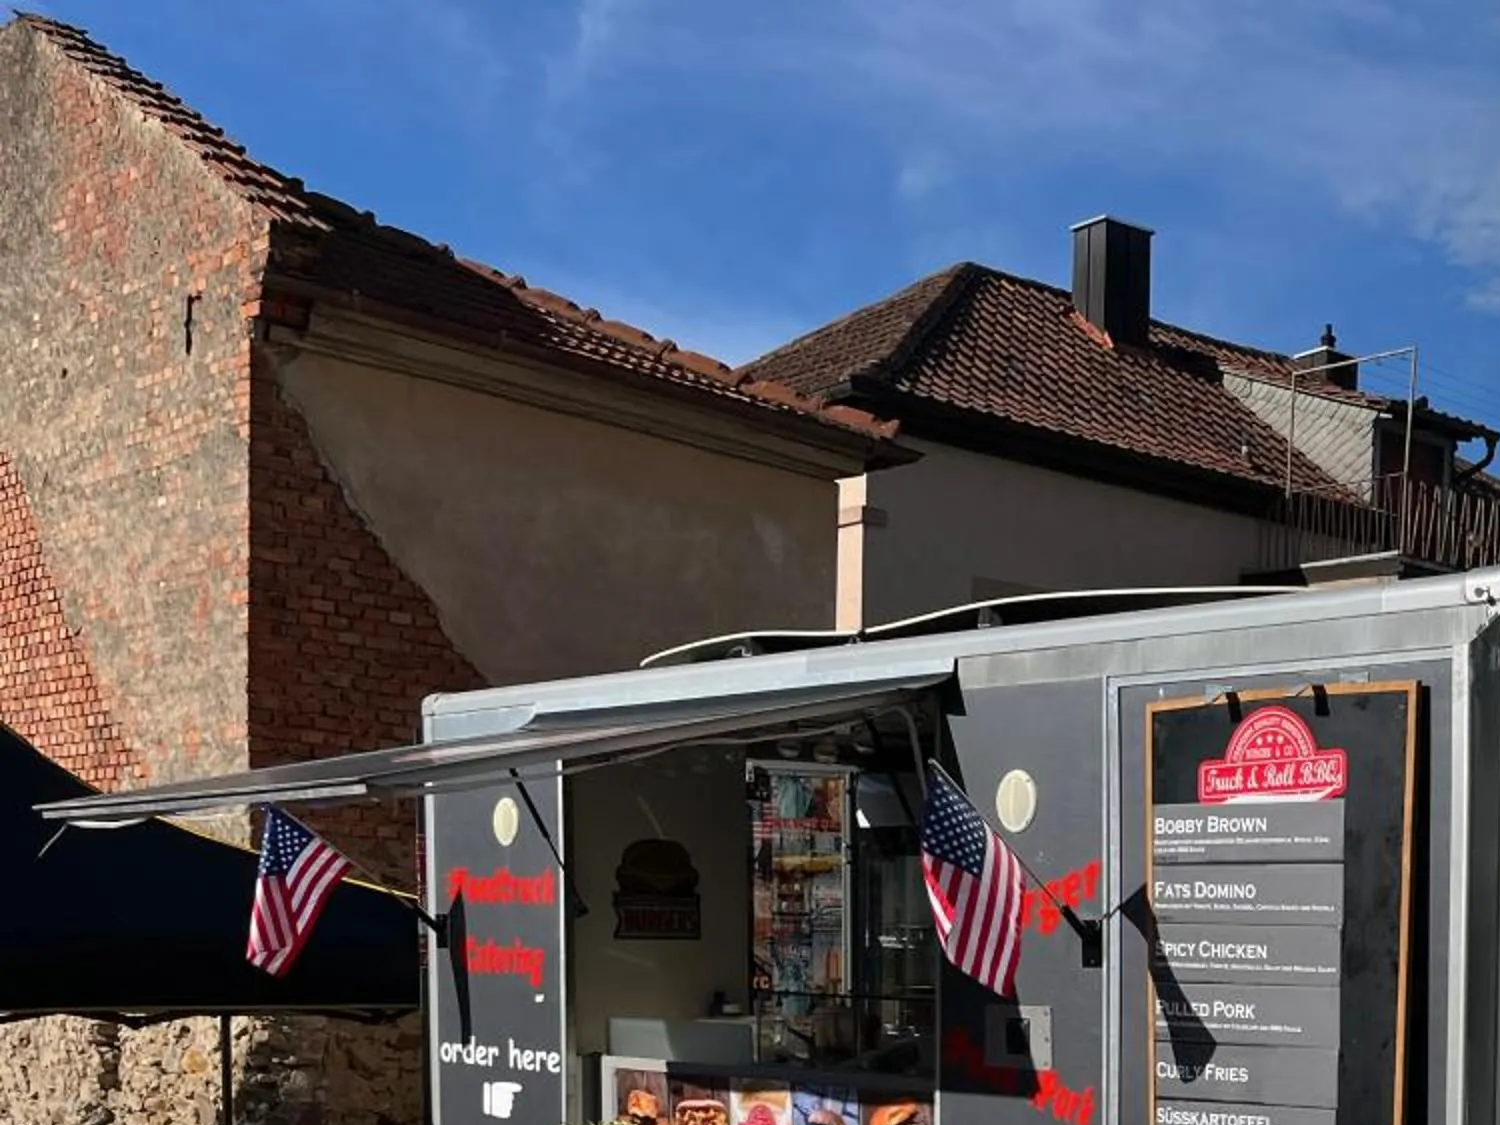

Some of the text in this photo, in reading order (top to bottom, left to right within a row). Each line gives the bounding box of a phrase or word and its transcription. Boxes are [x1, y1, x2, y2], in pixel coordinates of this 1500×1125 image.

[1205, 767, 1244, 793] Truck
[1262, 762, 1297, 788] Roll
[1299, 758, 1342, 786] BBQ
[1154, 815, 1267, 835] BOBBY BROWN
[1154, 881, 1257, 899] FATS DOMINO
[1199, 940, 1267, 959] CHICKEN
[1213, 1000, 1256, 1019] PORK
[440, 1035, 561, 1073] order here
[1205, 1063, 1249, 1083] FRIES
